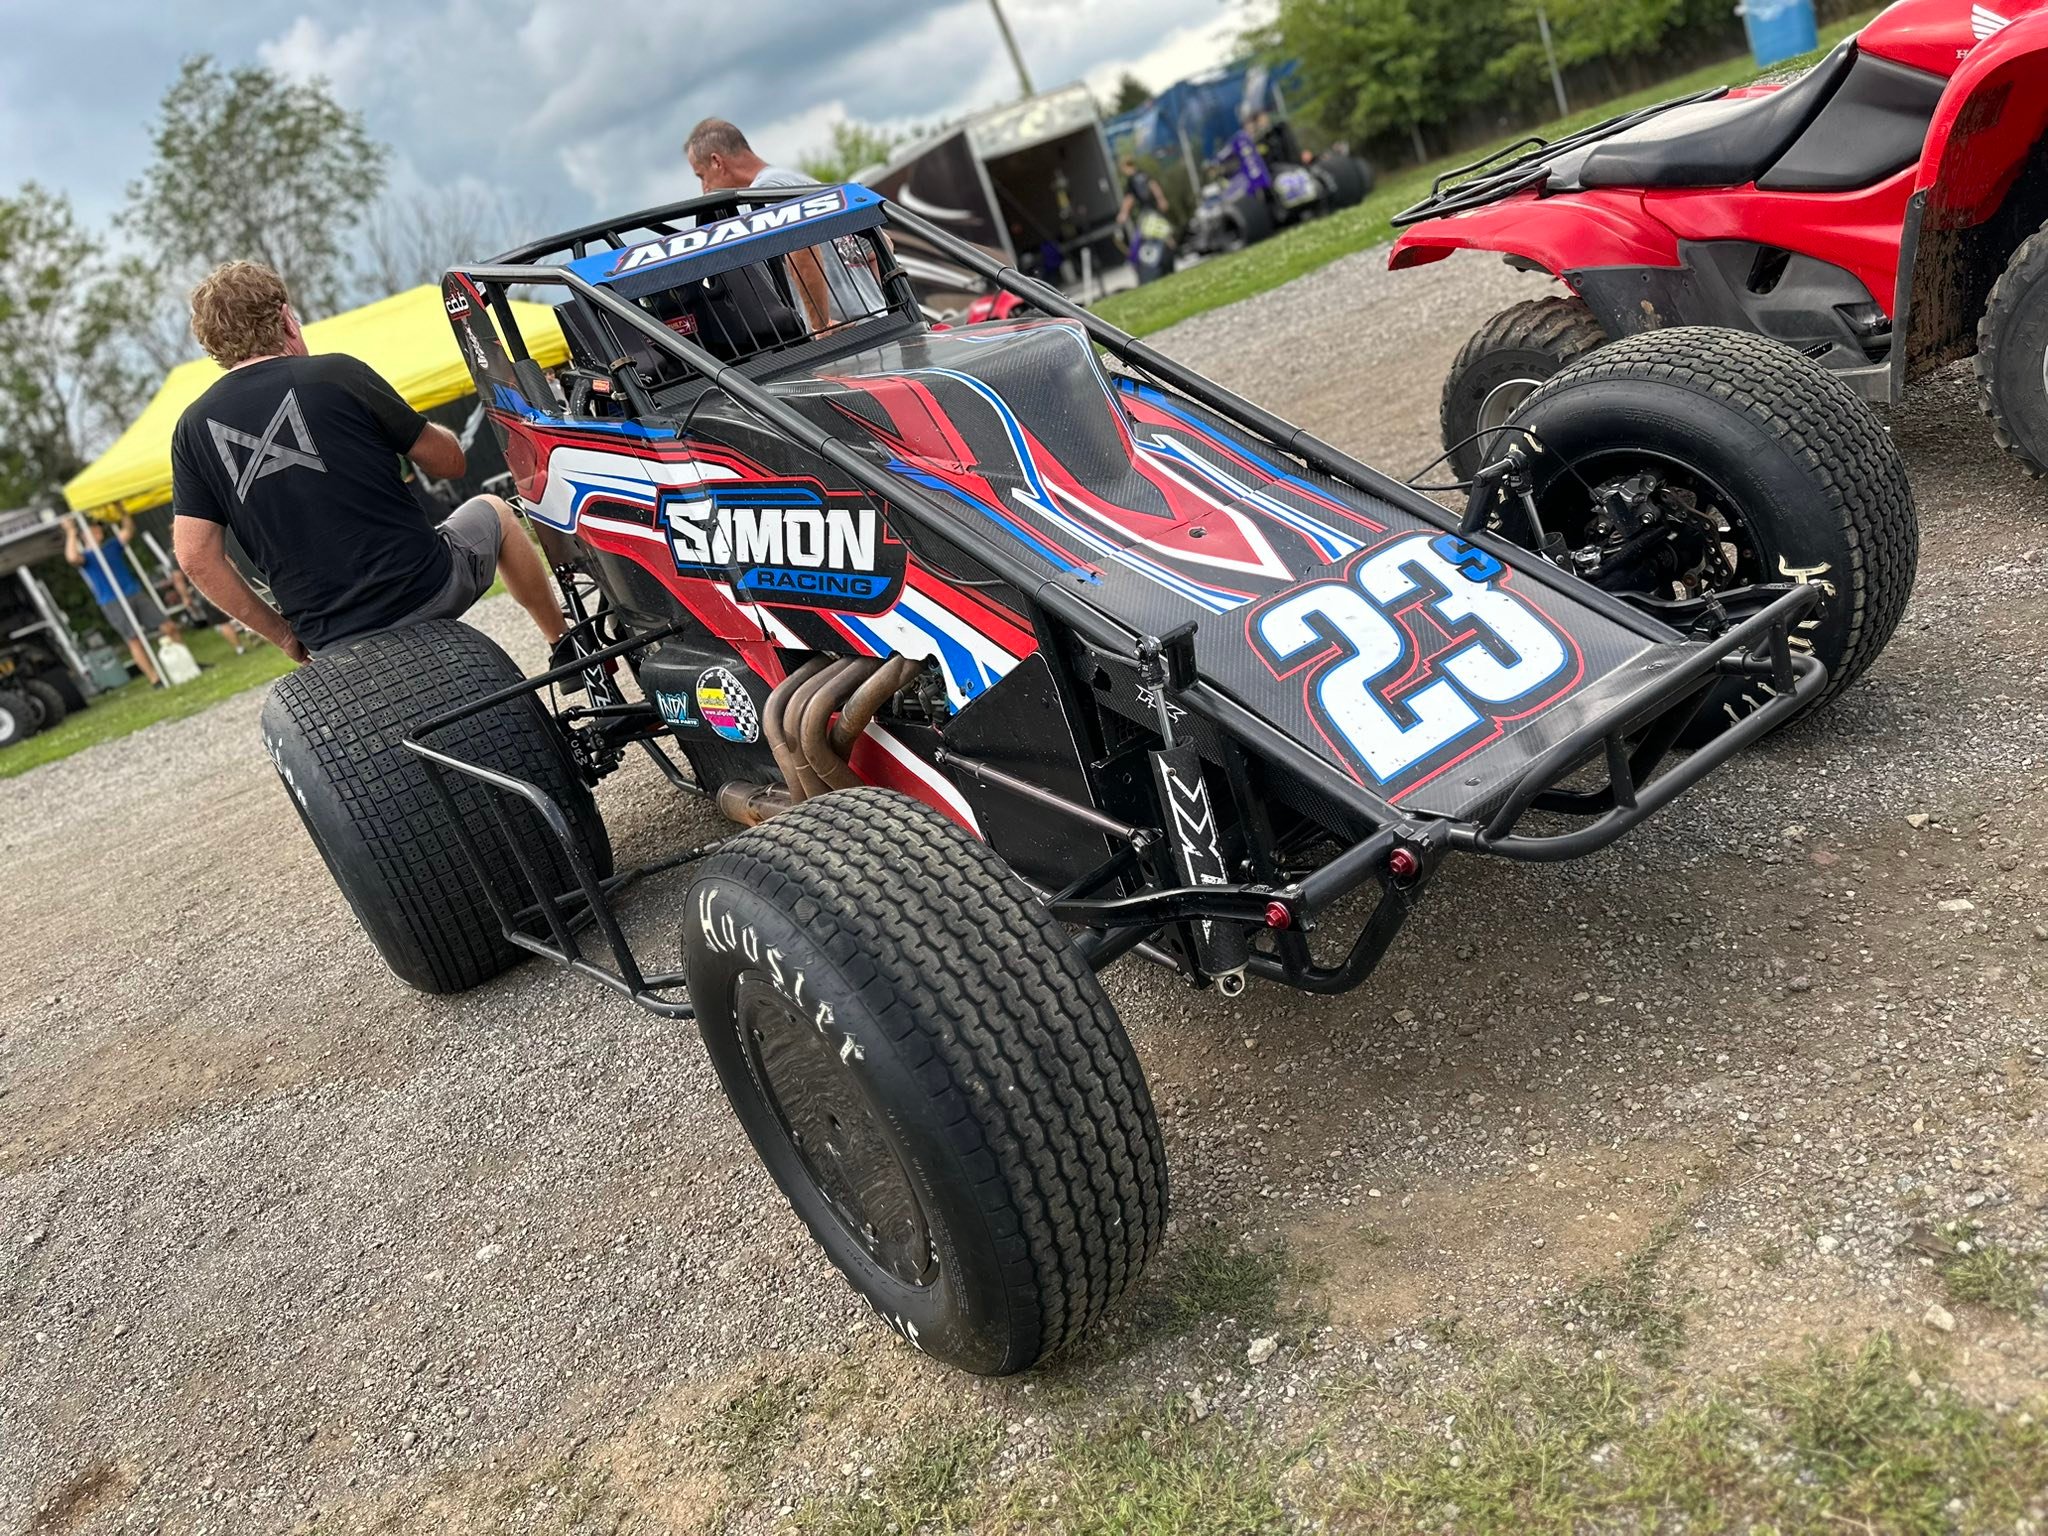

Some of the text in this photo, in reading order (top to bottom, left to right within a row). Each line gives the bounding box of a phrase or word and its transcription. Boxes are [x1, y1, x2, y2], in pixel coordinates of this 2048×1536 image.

[620, 192, 844, 271] ADAMS
[666, 499, 876, 571] SIMON
[757, 570, 872, 595] RACING
[1257, 534, 1567, 784] 23
[656, 691, 687, 720] INDY
